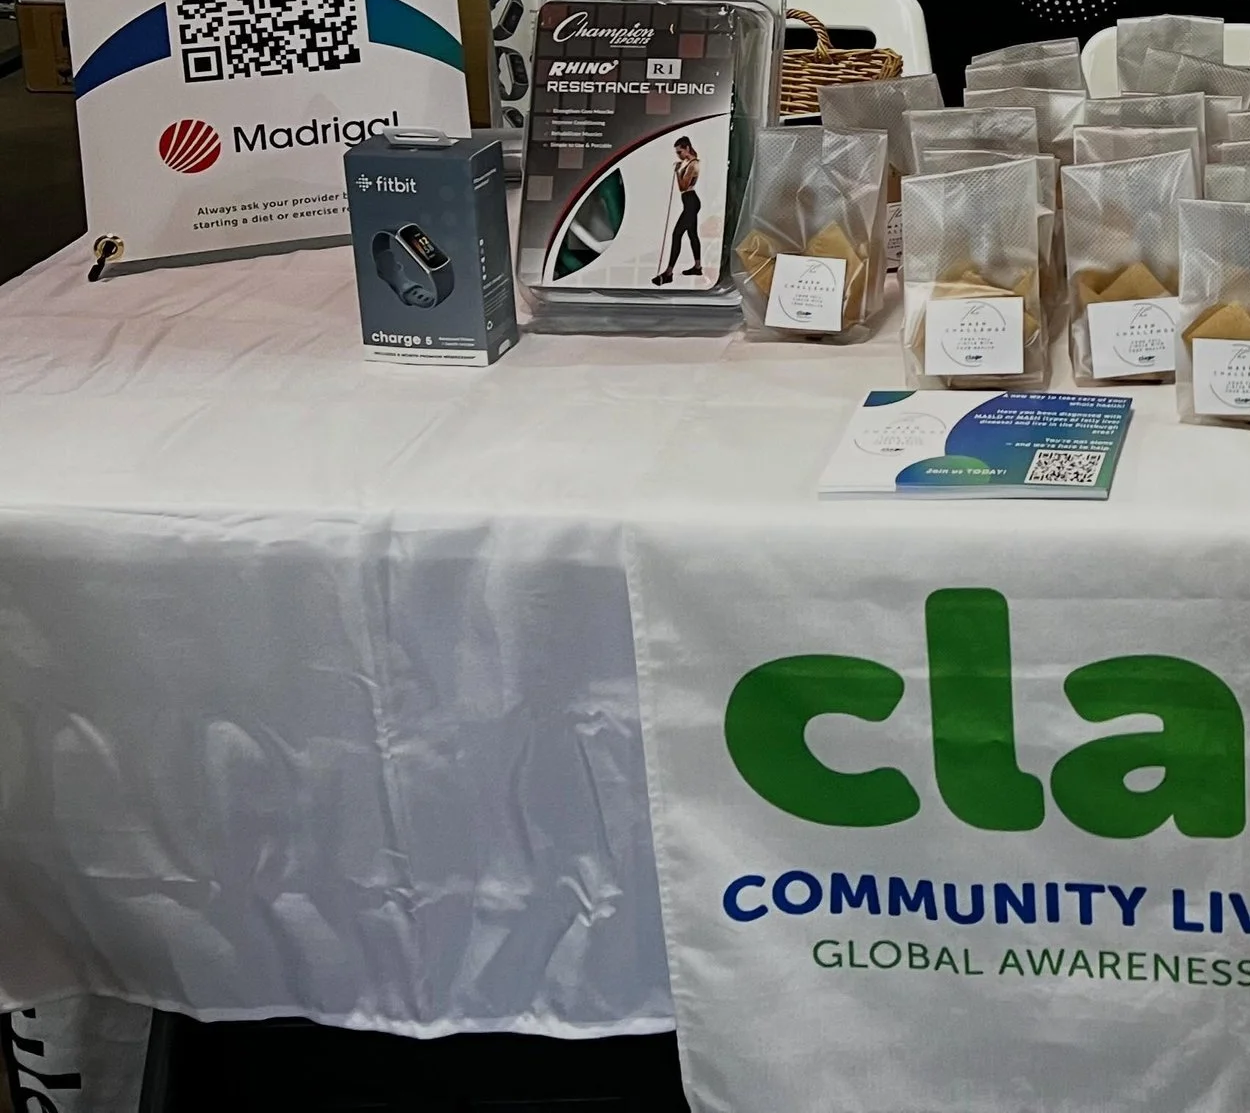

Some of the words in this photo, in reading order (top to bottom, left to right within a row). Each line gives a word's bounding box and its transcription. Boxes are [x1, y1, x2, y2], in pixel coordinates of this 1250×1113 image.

[553, 12, 654, 44] Champion
[549, 60, 619, 76] RHINO
[547, 81, 650, 93] RESISTANCE
[655, 83, 714, 94] TUBING
[376, 176, 416, 193] fitbit
[197, 203, 237, 216] Always
[241, 202, 259, 211] ask
[263, 199, 288, 210] your
[292, 193, 339, 207] provider
[193, 217, 238, 230] starting
[252, 214, 273, 223] diet
[277, 212, 289, 220] or
[293, 206, 338, 218] exercise
[372, 331, 421, 347] charge
[426, 336, 432, 345] 5
[926, 467, 949, 475] Join
[967, 468, 1007, 476] TODAY!
[723, 586, 1247, 841] cla
[722, 870, 1149, 928] COMMUNITY
[812, 939, 985, 979] GLOBAL
